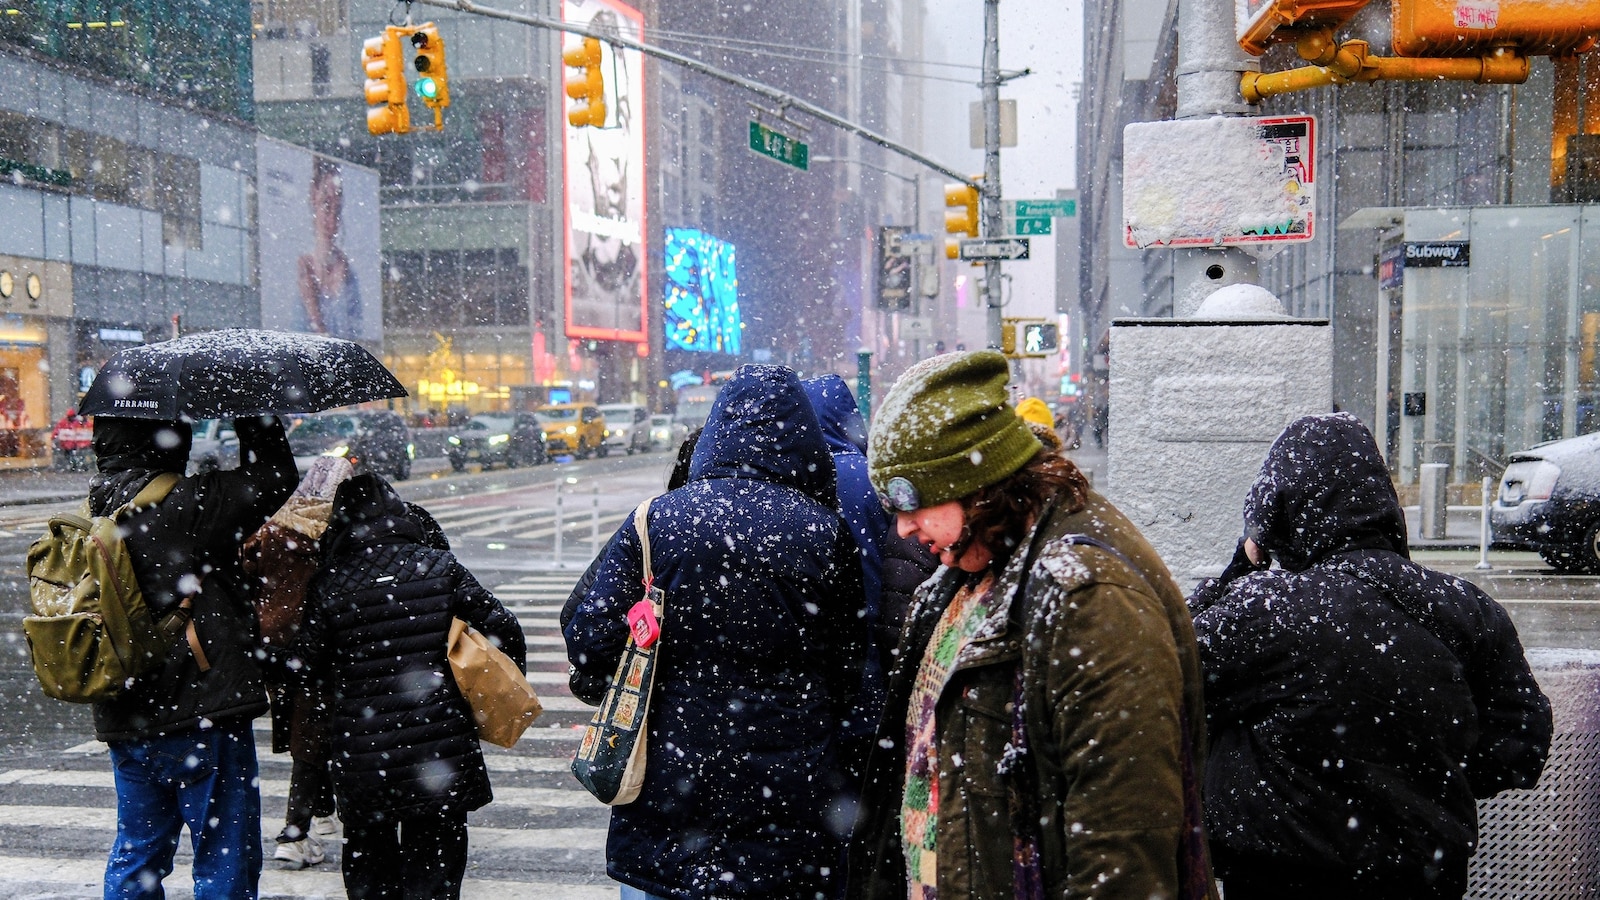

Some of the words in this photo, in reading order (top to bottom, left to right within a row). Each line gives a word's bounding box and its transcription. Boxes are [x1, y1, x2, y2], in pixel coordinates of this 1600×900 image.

[1022, 220, 1030, 234] 6
[969, 246, 988, 256] ONE
[999, 246, 1018, 255] WAY
[1406, 245, 1460, 260] Subway
[114, 400, 159, 409] PERRAMUS
